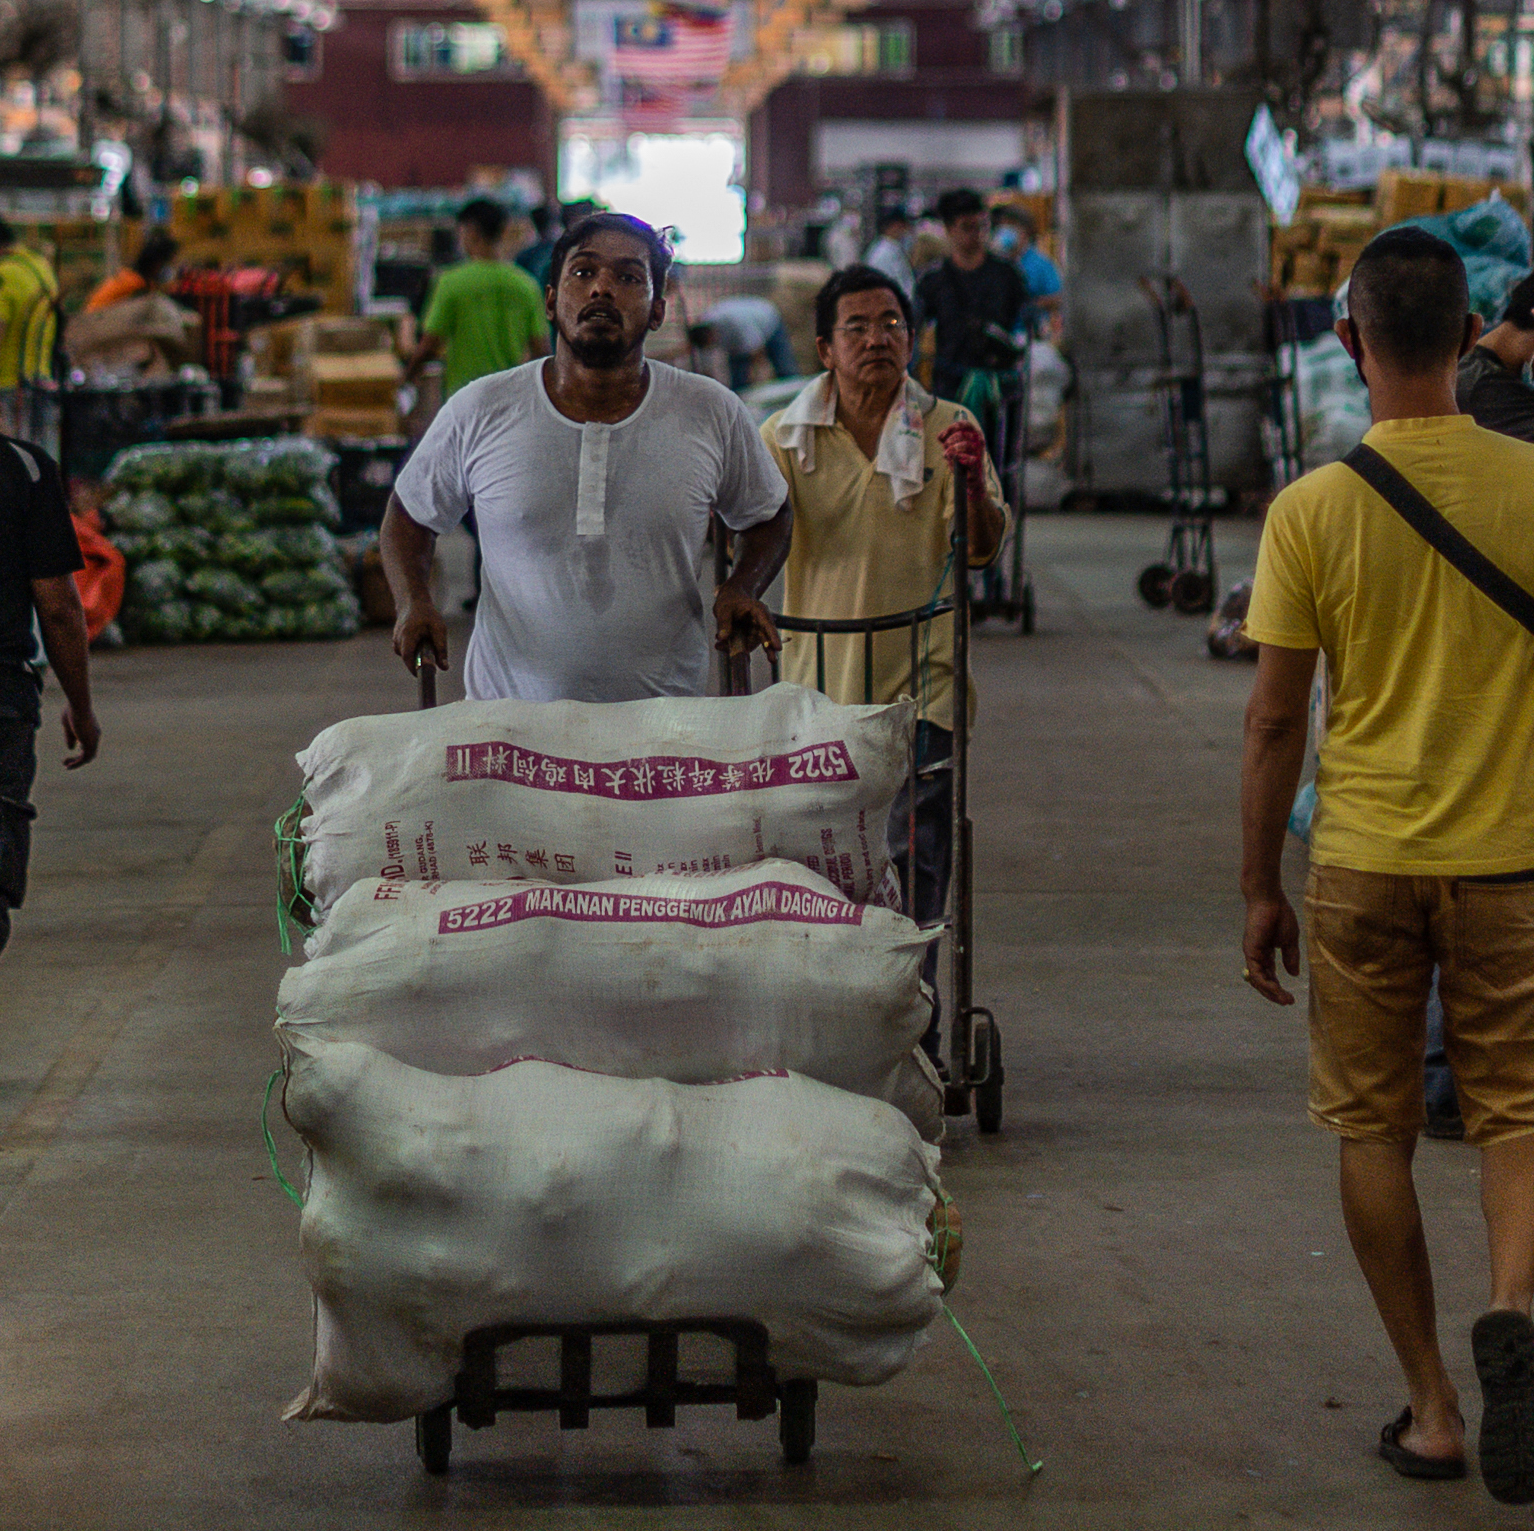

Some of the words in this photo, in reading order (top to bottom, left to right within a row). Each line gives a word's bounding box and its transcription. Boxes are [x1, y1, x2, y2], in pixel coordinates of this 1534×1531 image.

[789, 746, 846, 779] 5222
[445, 897, 514, 930] 5222
[525, 888, 615, 917] MAKANAN
[618, 896, 726, 923] PENGGEMUK
[729, 887, 777, 921] AYAM
[780, 890, 839, 918] DAGING
